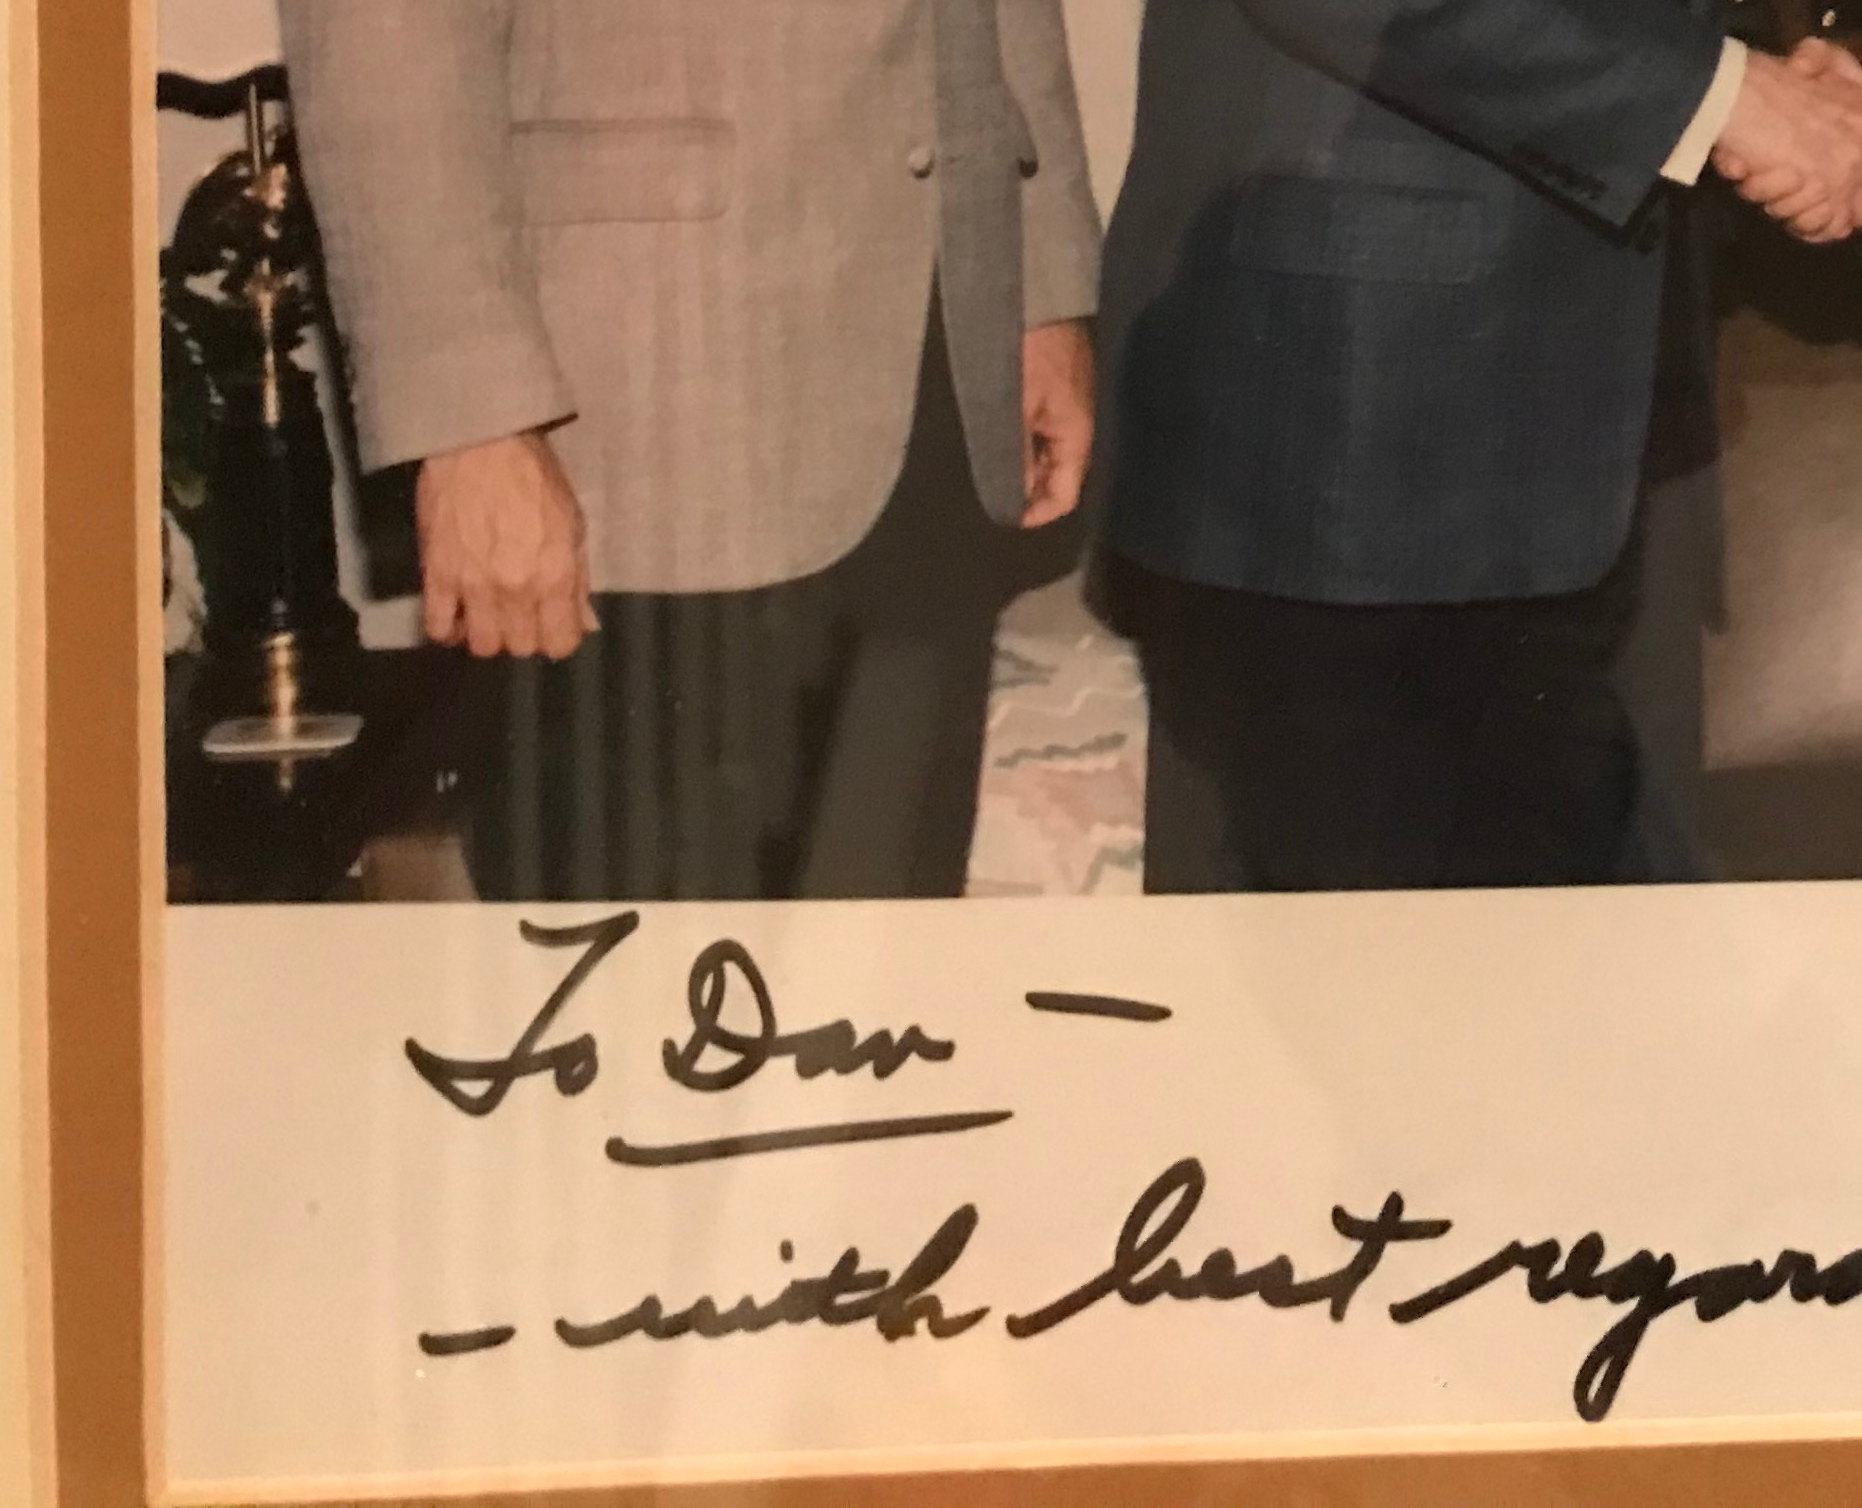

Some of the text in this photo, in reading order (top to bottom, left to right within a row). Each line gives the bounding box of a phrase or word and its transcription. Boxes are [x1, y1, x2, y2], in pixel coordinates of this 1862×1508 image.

[404, 910, 640, 1117] To
[662, 939, 956, 1094] Dan
[554, 1203, 990, 1349] with
[1005, 1157, 1453, 1340] best
